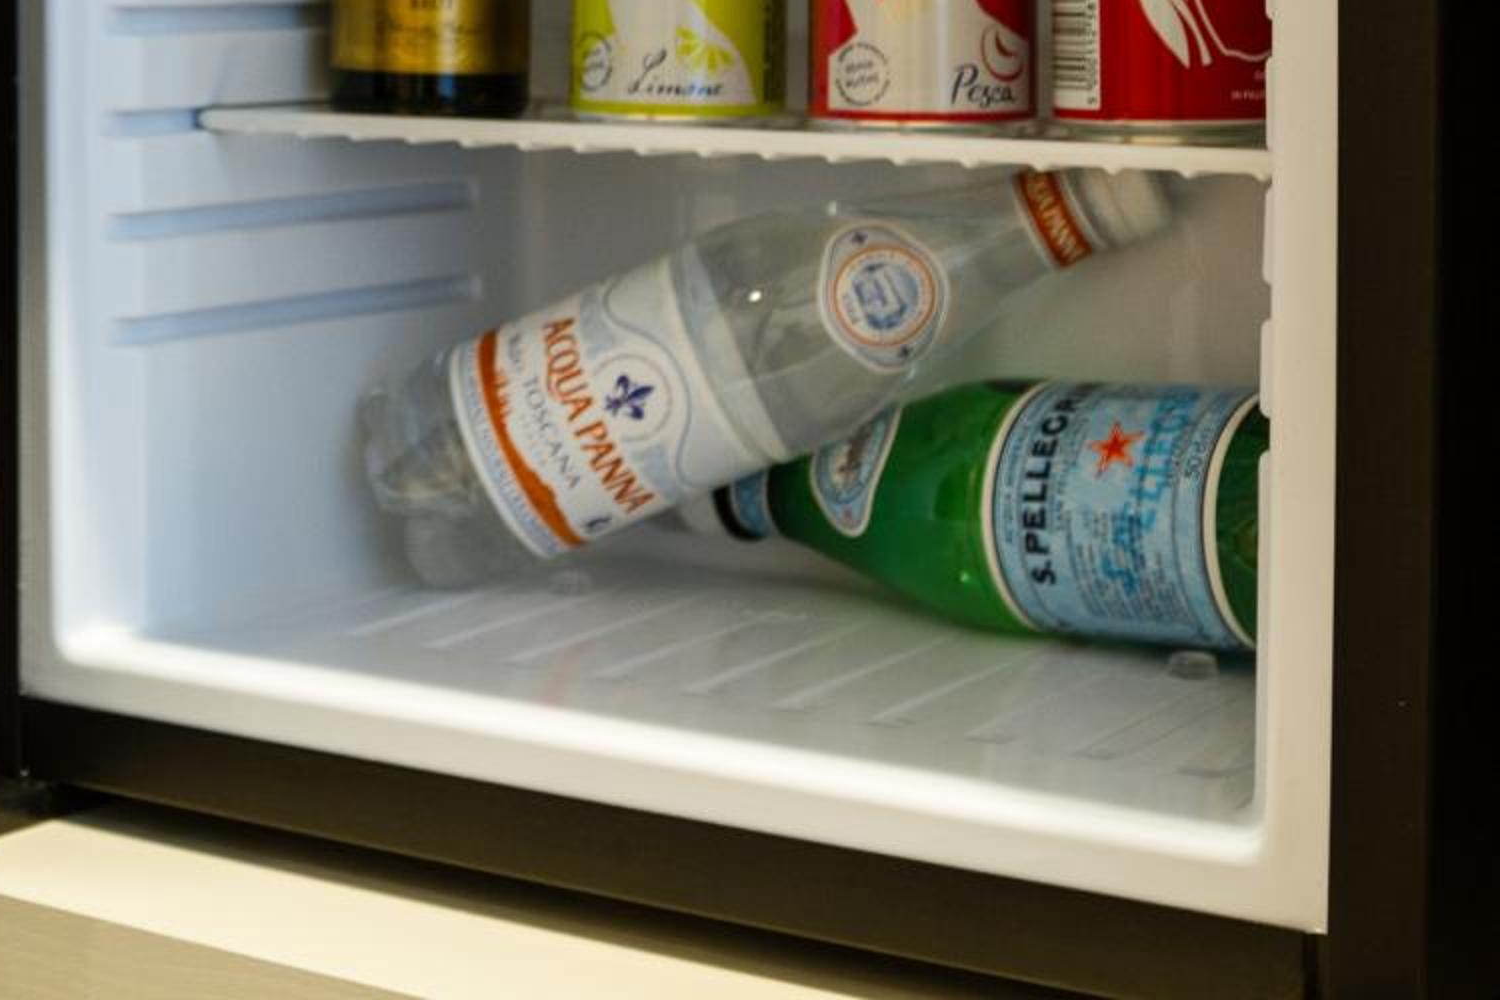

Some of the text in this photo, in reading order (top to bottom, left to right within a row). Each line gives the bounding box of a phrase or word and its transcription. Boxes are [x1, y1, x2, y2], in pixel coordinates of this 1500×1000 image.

[951, 64, 1017, 107] Pesca
[523, 376, 582, 489] TOSCANA
[543, 317, 655, 515] ACQUA PANNA
